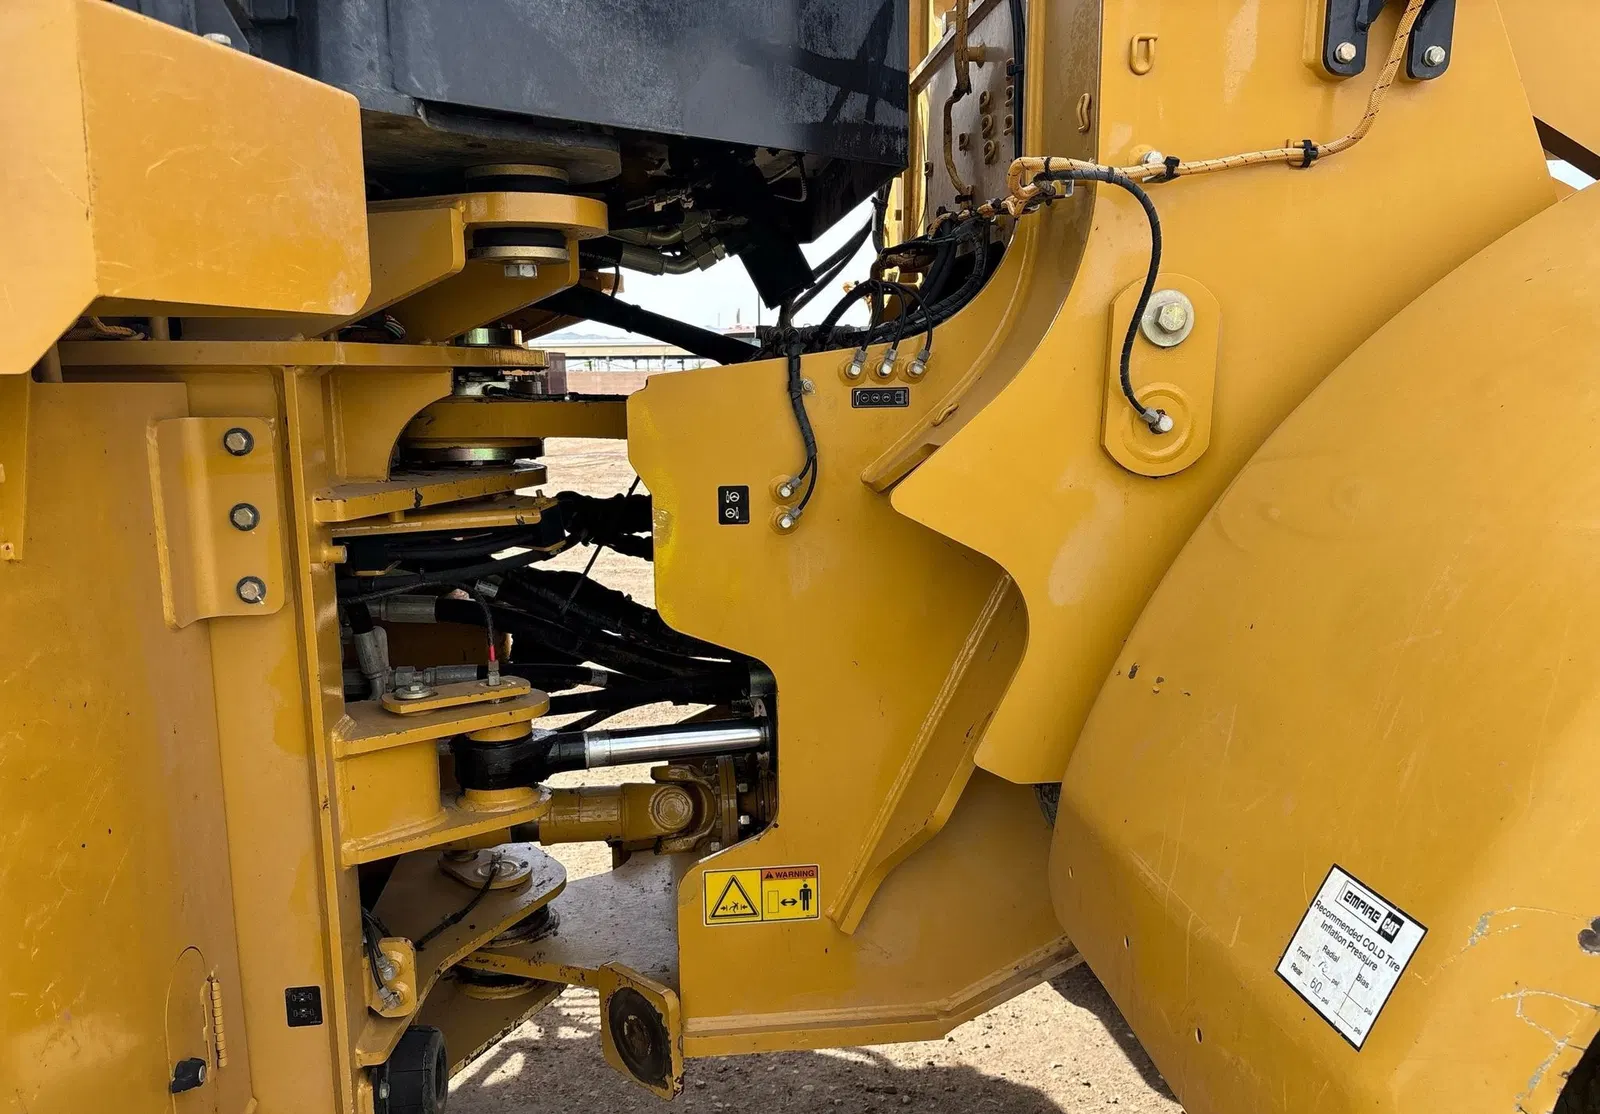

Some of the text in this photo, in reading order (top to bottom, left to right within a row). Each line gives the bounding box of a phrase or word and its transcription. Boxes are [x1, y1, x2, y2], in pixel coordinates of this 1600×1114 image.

[775, 869, 815, 879] WARNING
[1343, 890, 1381, 924] EMPIRE
[1381, 917, 1401, 936] CAT
[1314, 900, 1401, 973] Recommended COLD Tire
[1320, 920, 1378, 971] Inflation Pressure
[1296, 946, 1311, 962] Front
[1290, 962, 1303, 976] Rear
[1322, 944, 1370, 989] Radial Bias
[1321, 996, 1330, 1006] psi
[1363, 1007, 1373, 1016] psi
[1353, 1026, 1363, 1036] psi
